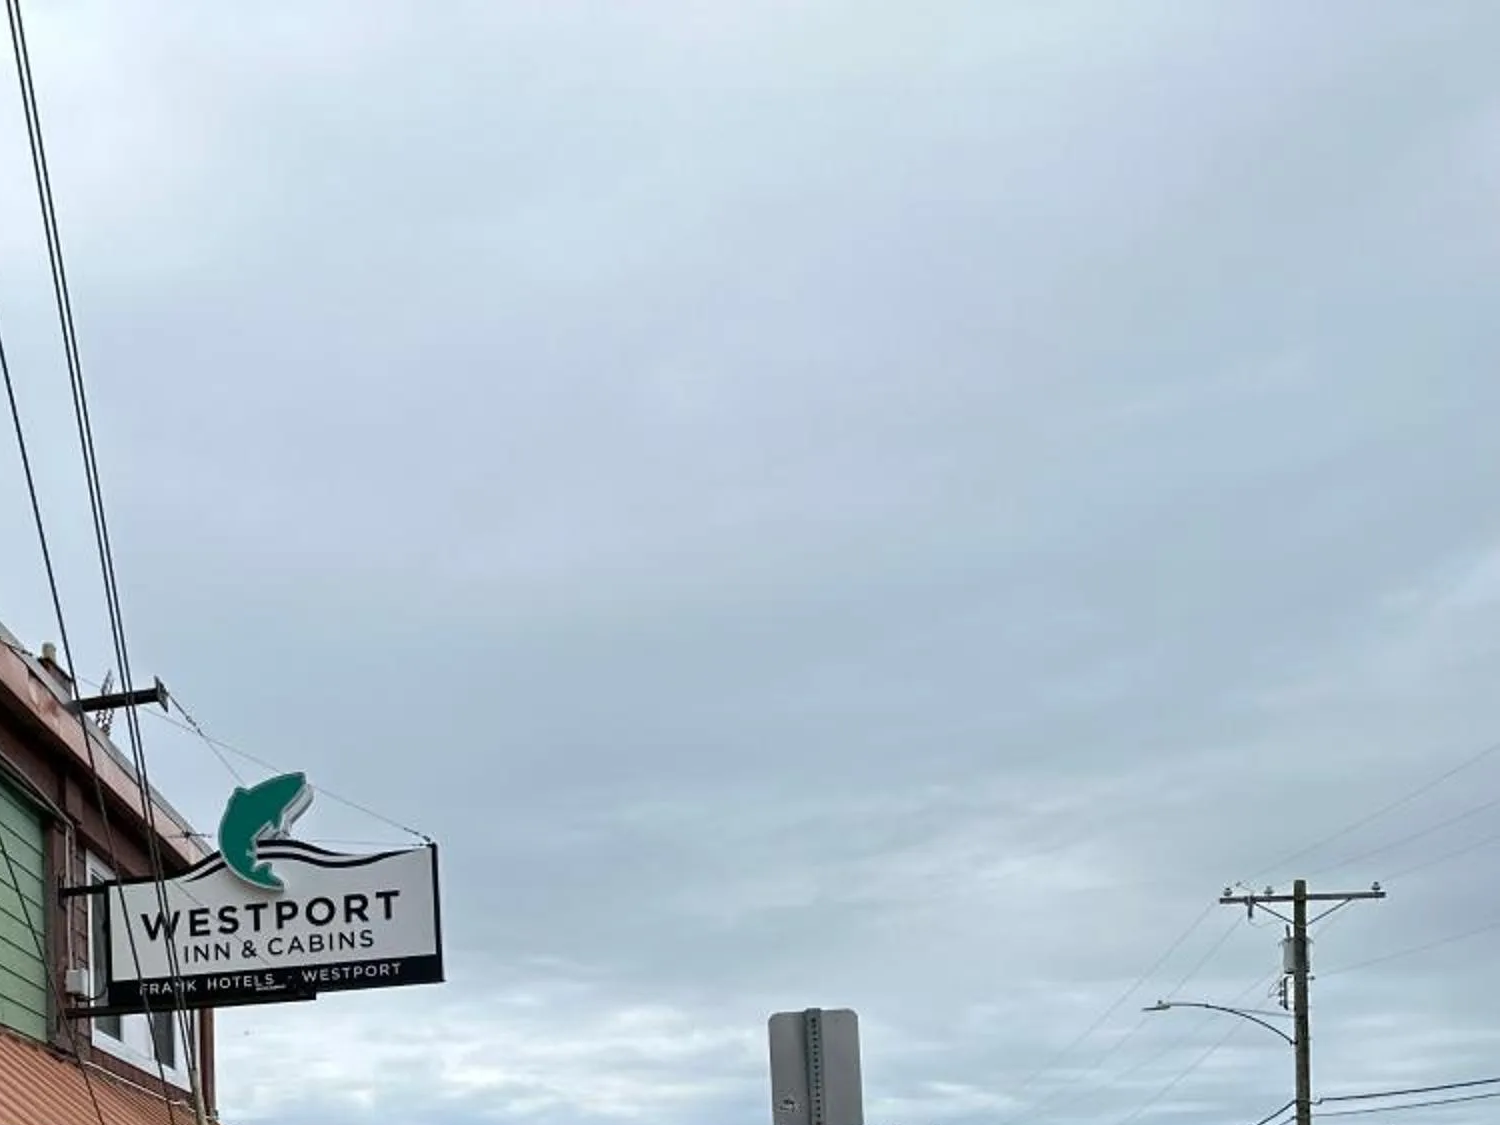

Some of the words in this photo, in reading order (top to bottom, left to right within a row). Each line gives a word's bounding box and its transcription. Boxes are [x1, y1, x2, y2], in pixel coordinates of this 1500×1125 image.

[141, 890, 400, 941] WESTPORT
[184, 942, 230, 964] INN
[241, 940, 257, 958] &
[267, 929, 374, 955] CABINS
[207, 973, 275, 990] HOTELS
[301, 962, 401, 982] WESTPORT
